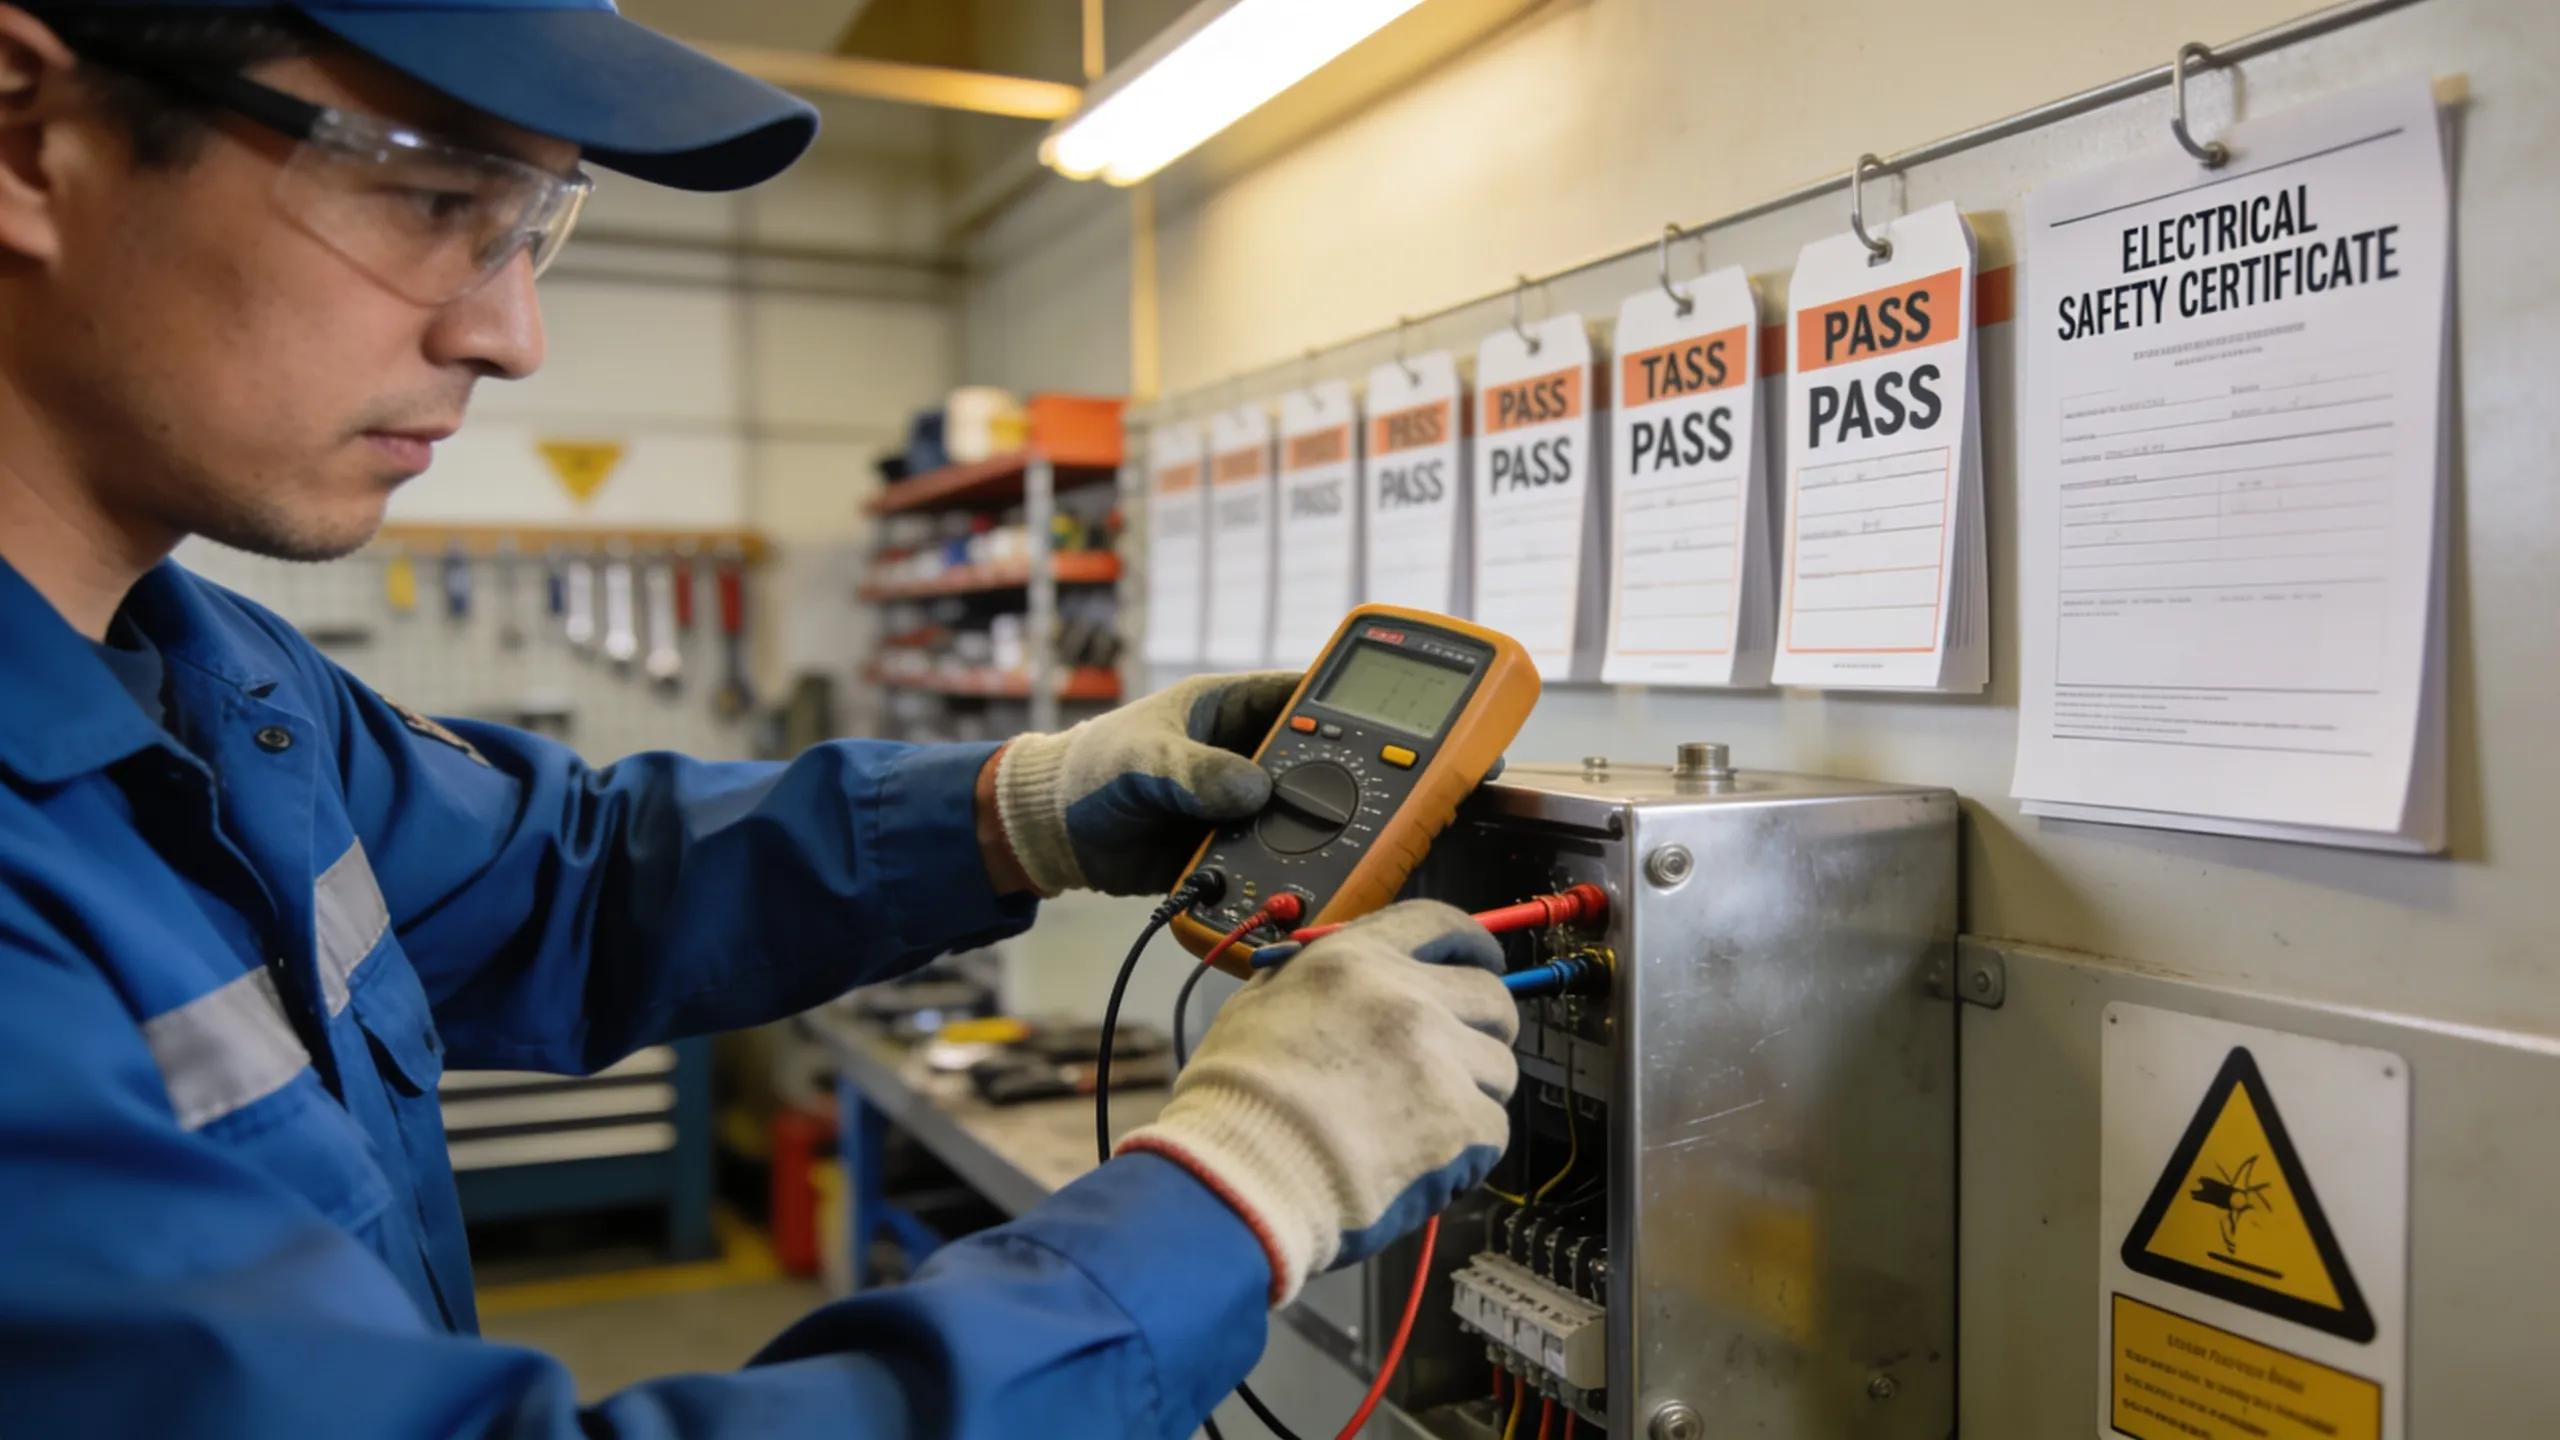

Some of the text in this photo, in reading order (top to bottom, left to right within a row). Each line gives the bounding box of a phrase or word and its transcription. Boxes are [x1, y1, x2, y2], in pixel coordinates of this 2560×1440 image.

[2121, 185, 2317, 274] ELECTRICAL
[2058, 226, 2400, 341] SAFETY CERTIFICATE
[1824, 290, 1931, 361] PASS
[1498, 378, 1567, 427] PASS
[1641, 340, 1728, 401] TASS
[1809, 364, 1942, 449] PASS
[1490, 436, 1571, 495] PASS
[1630, 407, 1734, 476] PASS
[1378, 458, 1443, 510] PASS
